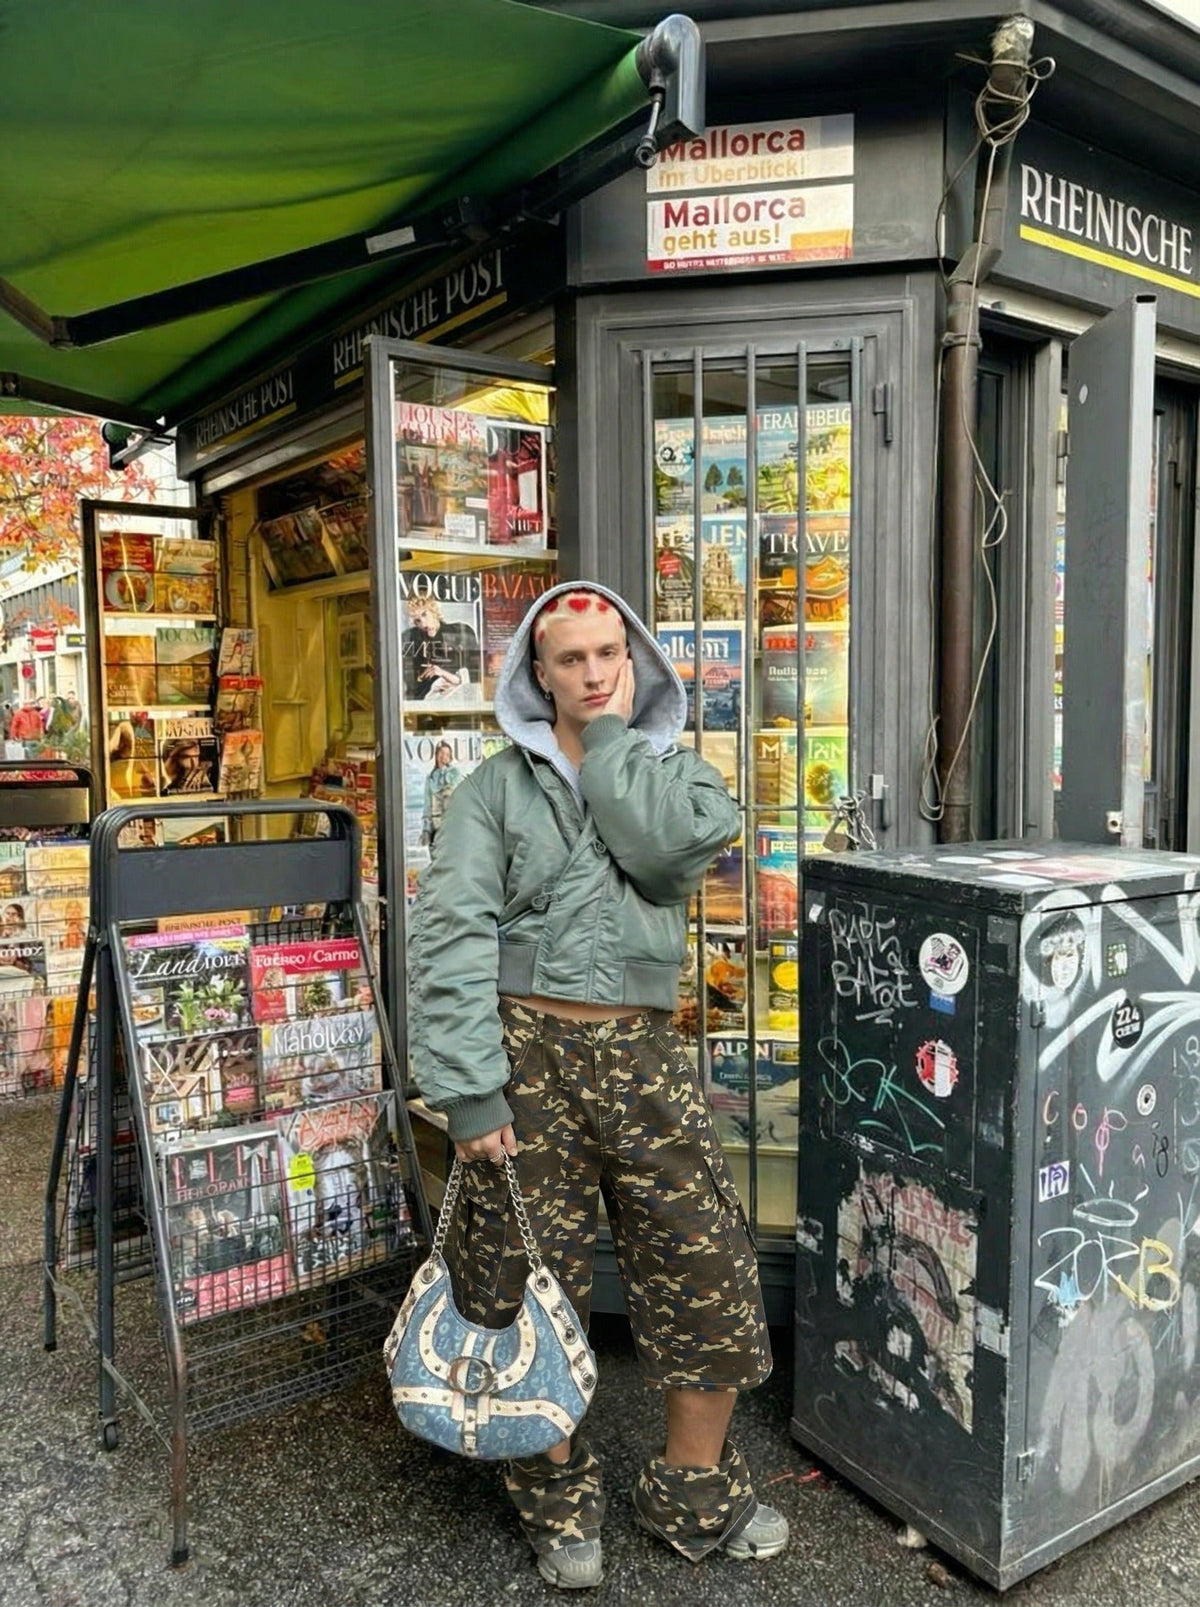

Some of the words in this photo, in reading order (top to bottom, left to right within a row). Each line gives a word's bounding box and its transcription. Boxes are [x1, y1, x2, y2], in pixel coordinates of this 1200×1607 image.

[659, 129, 805, 164] Mallorca
[664, 196, 806, 229] Mallorca
[1020, 163, 1192, 275] RHEINISCHE
[663, 229, 718, 256] geht
[728, 223, 781, 247] aus!
[446, 248, 503, 315] POST
[196, 392, 258, 449] RHEINISCHE
[260, 368, 295, 414] POST
[399, 573, 481, 602] VOGUE
[404, 736, 482, 763] VOUE
[711, 1041, 770, 1058] ALPN
